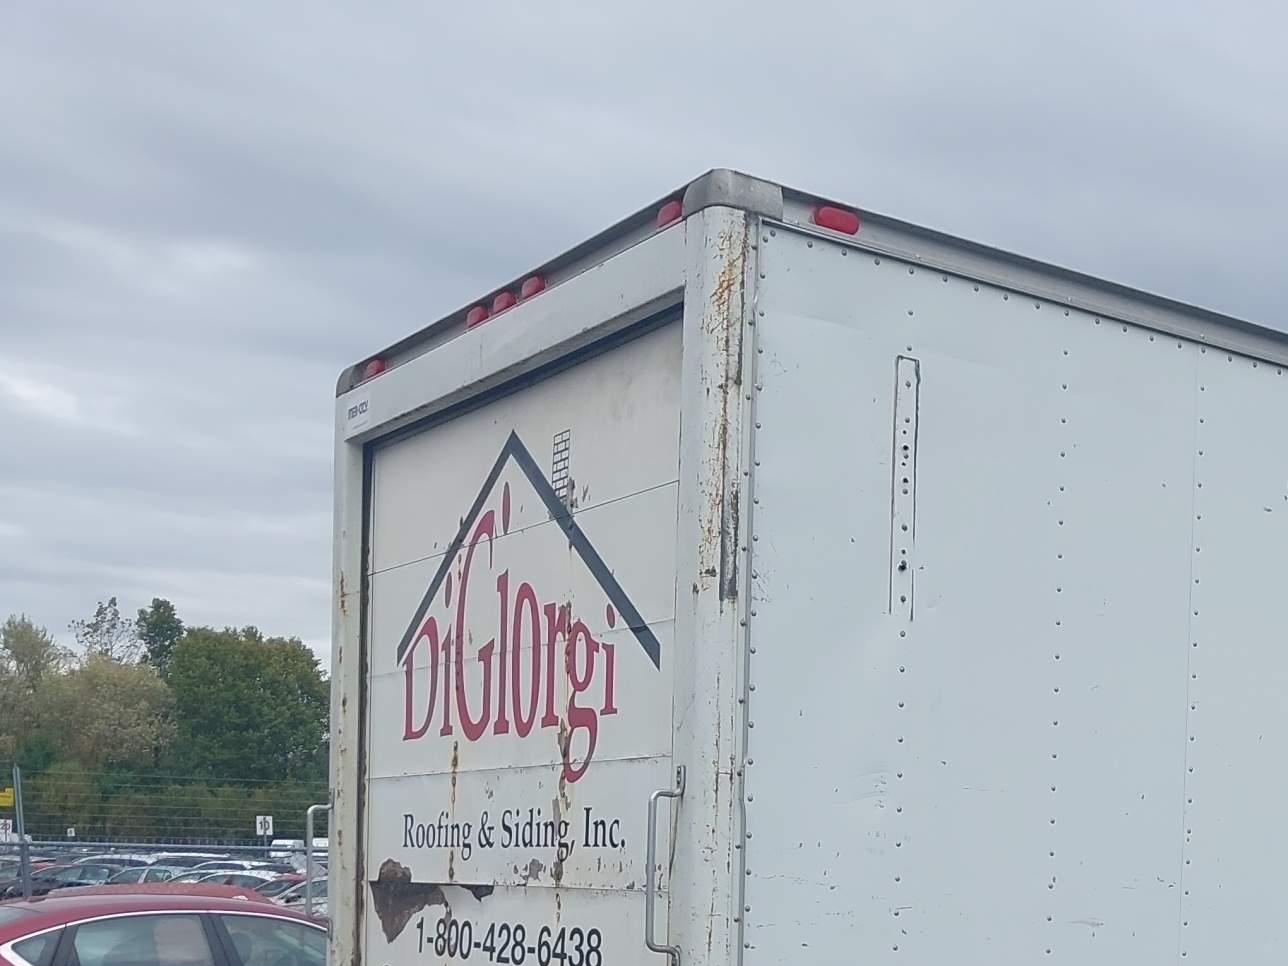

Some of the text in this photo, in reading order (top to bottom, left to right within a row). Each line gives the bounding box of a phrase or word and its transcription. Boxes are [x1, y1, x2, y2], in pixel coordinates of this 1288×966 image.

[402, 481, 618, 783] DiGiorgi
[403, 806, 626, 862] Roofing & Siding, Inc.
